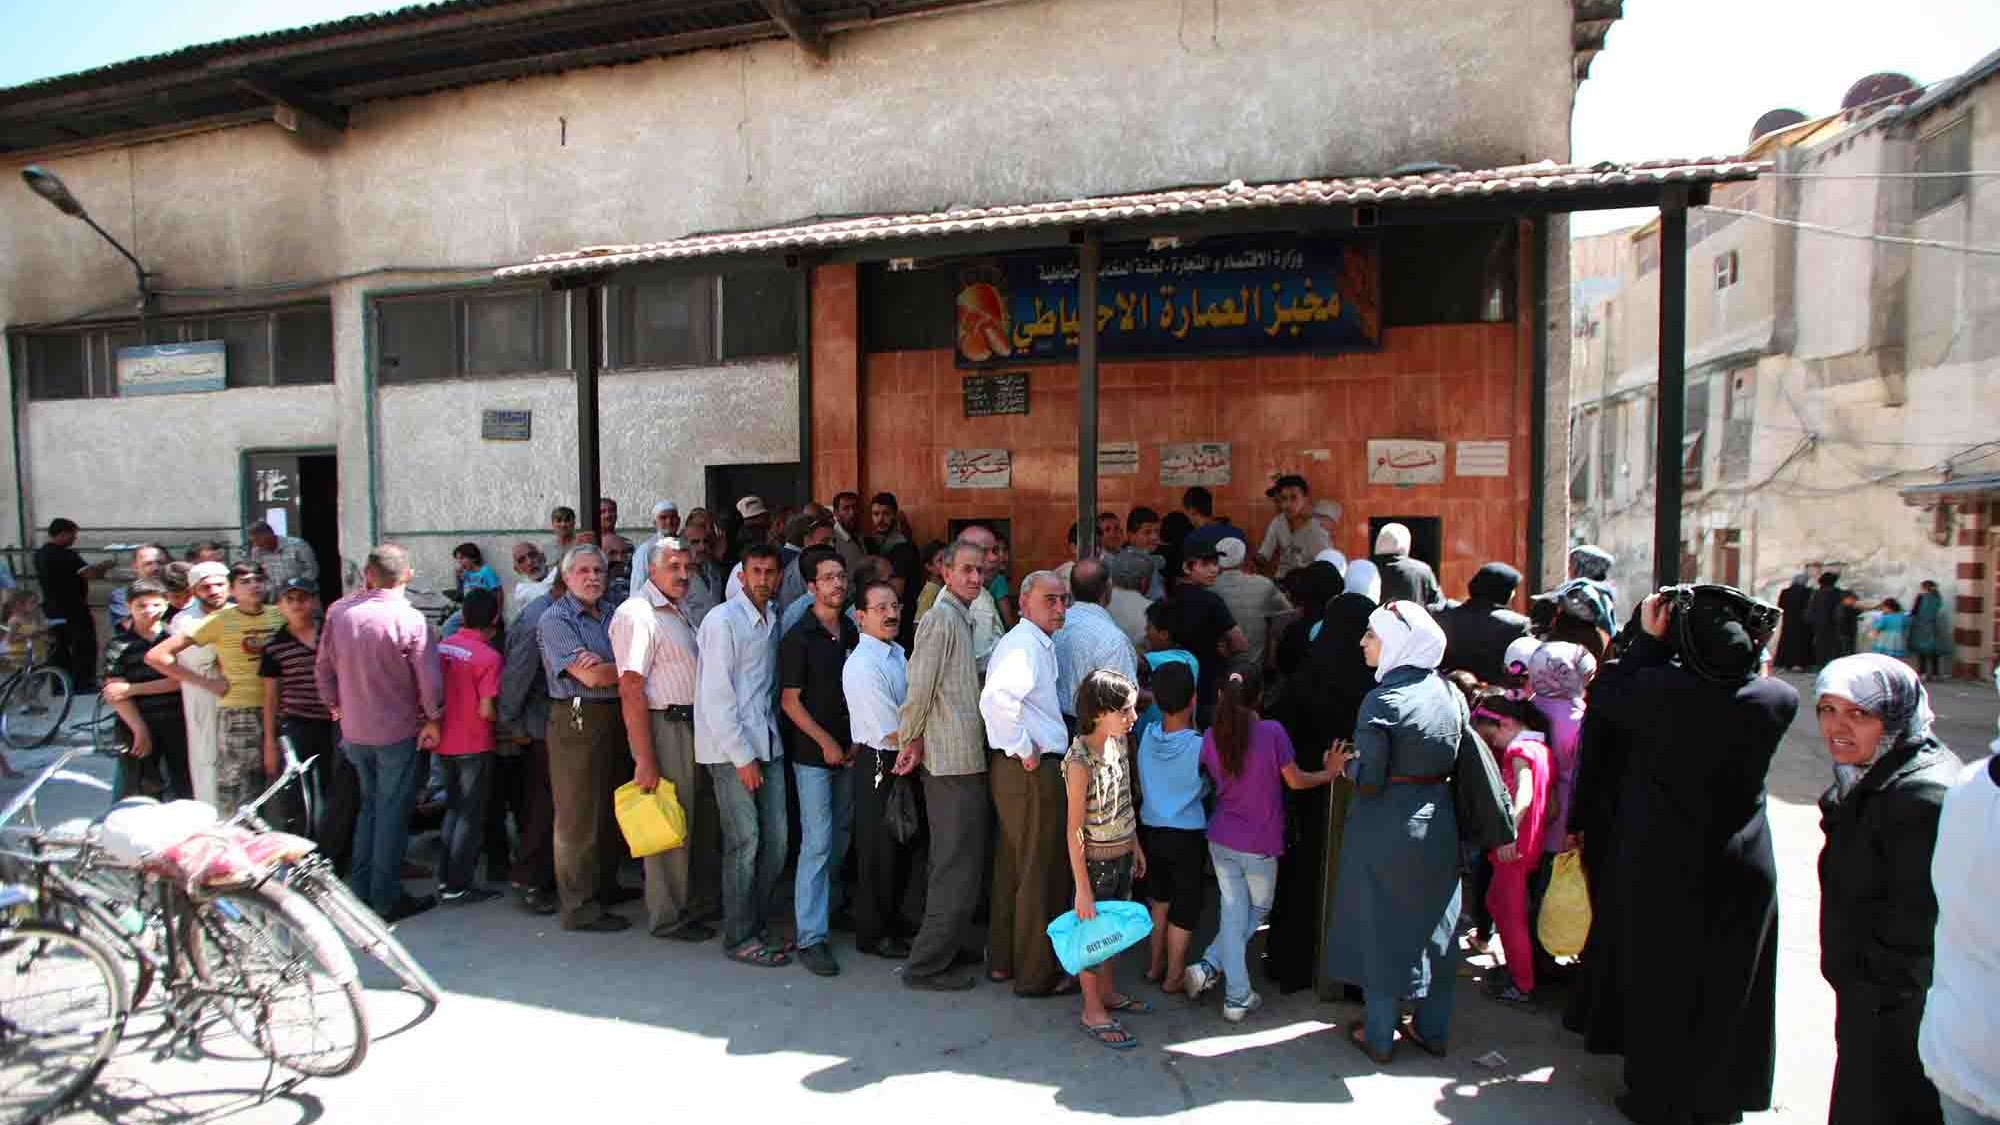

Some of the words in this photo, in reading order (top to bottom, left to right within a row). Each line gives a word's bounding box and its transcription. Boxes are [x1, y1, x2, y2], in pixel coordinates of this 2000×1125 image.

[1160, 284, 1261, 339] العمارة
[1264, 278, 1342, 338] مخبز
[1373, 448, 1437, 475] نساء
